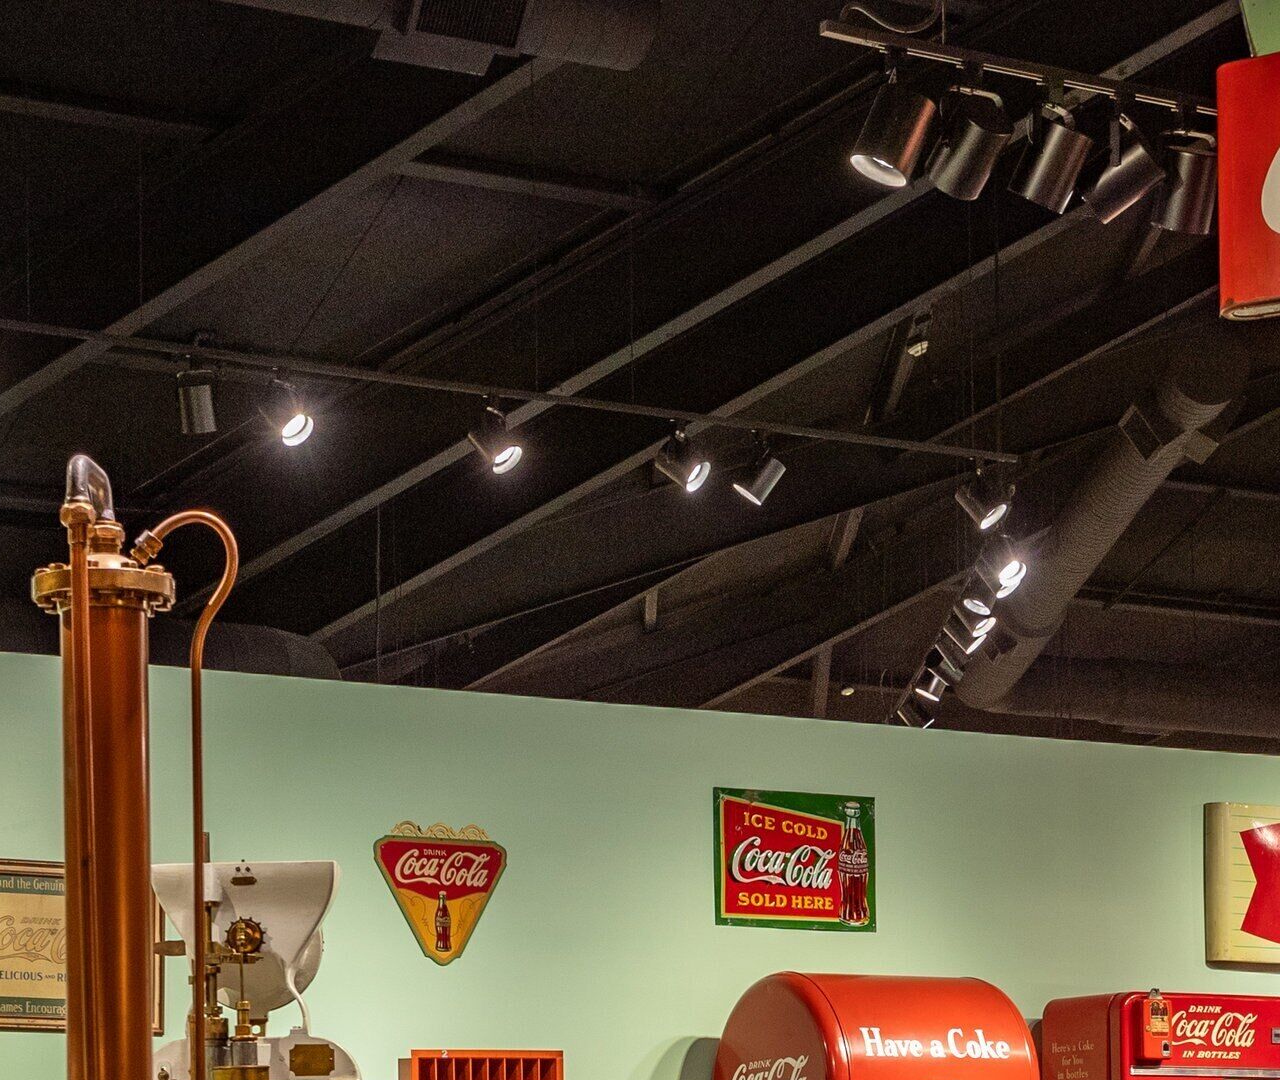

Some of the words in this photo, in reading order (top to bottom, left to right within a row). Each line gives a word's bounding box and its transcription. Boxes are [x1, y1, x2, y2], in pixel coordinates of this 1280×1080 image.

[743, 811, 776, 831] ICE
[781, 819, 828, 840] COLD
[423, 848, 448, 857] DRINK
[394, 848, 491, 888] Coca-Cola
[731, 836, 837, 890] Coca-Cola
[16, 877, 32, 890] the
[33, 878, 66, 892] Genuin
[737, 892, 788, 908] SOLD
[791, 895, 834, 911] HERE
[25, 1001, 67, 1017] Encourag
[1188, 1005, 1223, 1014] DRINK
[859, 1027, 923, 1059] Have
[929, 1038, 947, 1059] a
[946, 1027, 1011, 1060] Coke
[1051, 1042, 1071, 1054] Here's
[1077, 1040, 1094, 1052] Coke
[1061, 1056, 1071, 1066] for
[1072, 1055, 1084, 1066] You
[1182, 1050, 1194, 1058] IN
[1196, 1050, 1241, 1060] BOTTLES
[748, 1058, 772, 1070] DRINK
[1057, 1070, 1064, 1080] in
[1065, 1068, 1089, 1080] bottles
